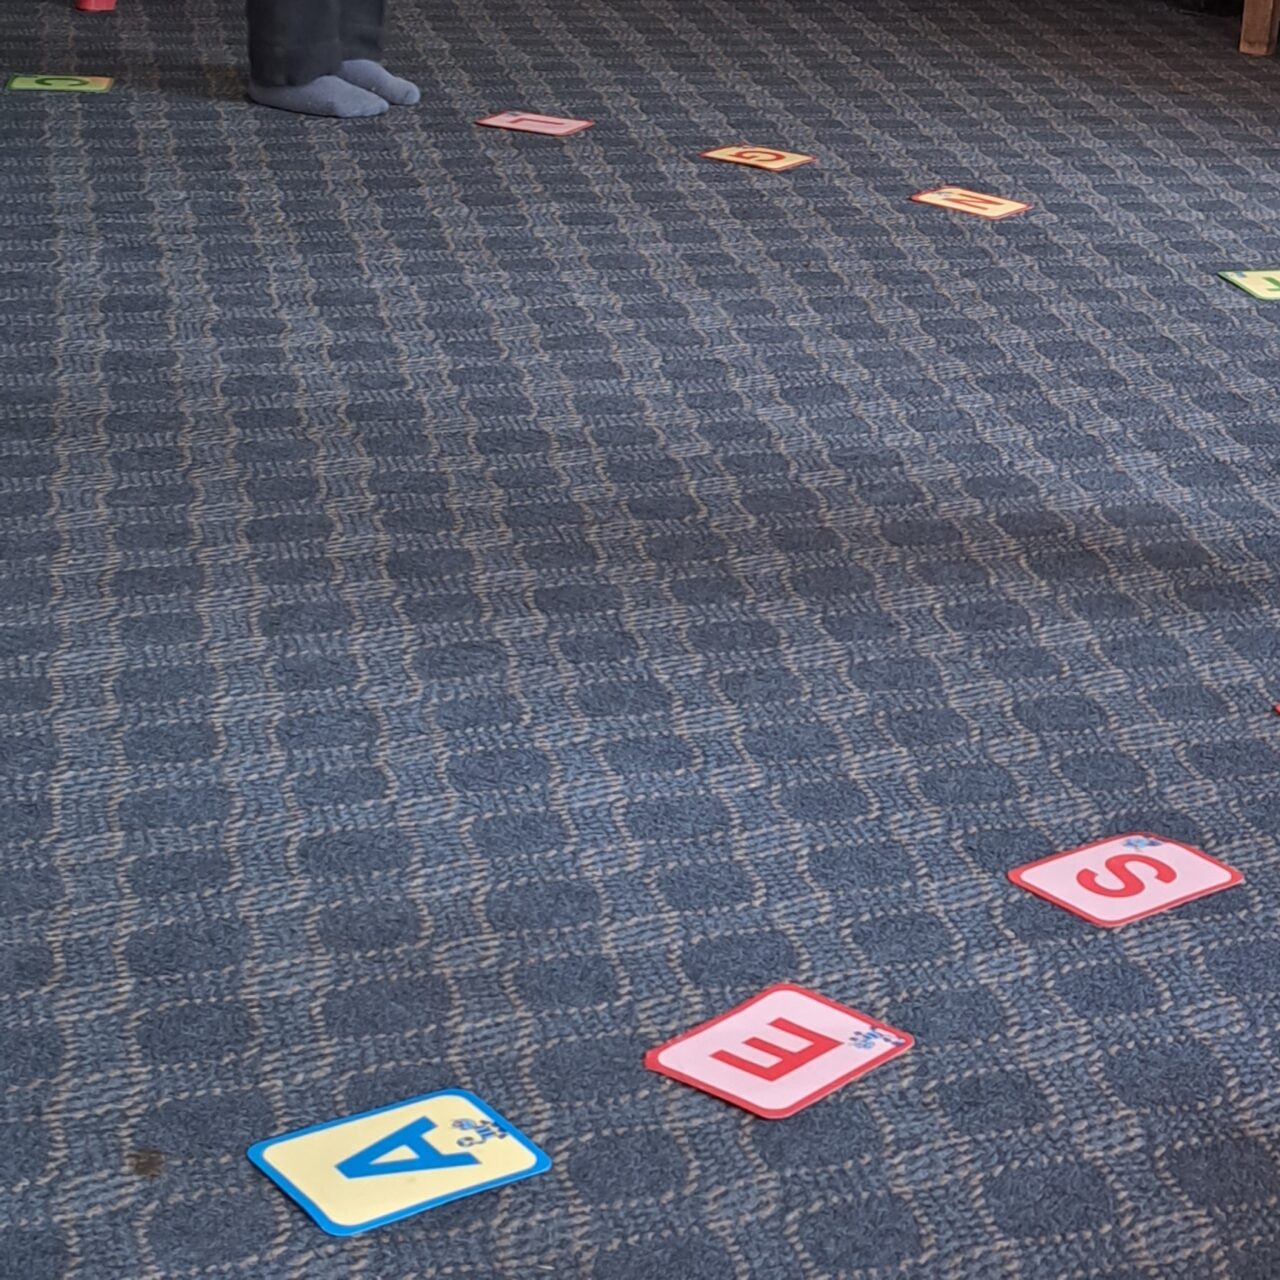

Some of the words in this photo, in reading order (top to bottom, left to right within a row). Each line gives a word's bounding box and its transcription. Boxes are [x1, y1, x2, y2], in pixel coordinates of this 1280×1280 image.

[728, 150, 786, 162] G
[1076, 853, 1177, 898] S
[709, 1017, 845, 1082] E
[335, 1116, 481, 1179] A
